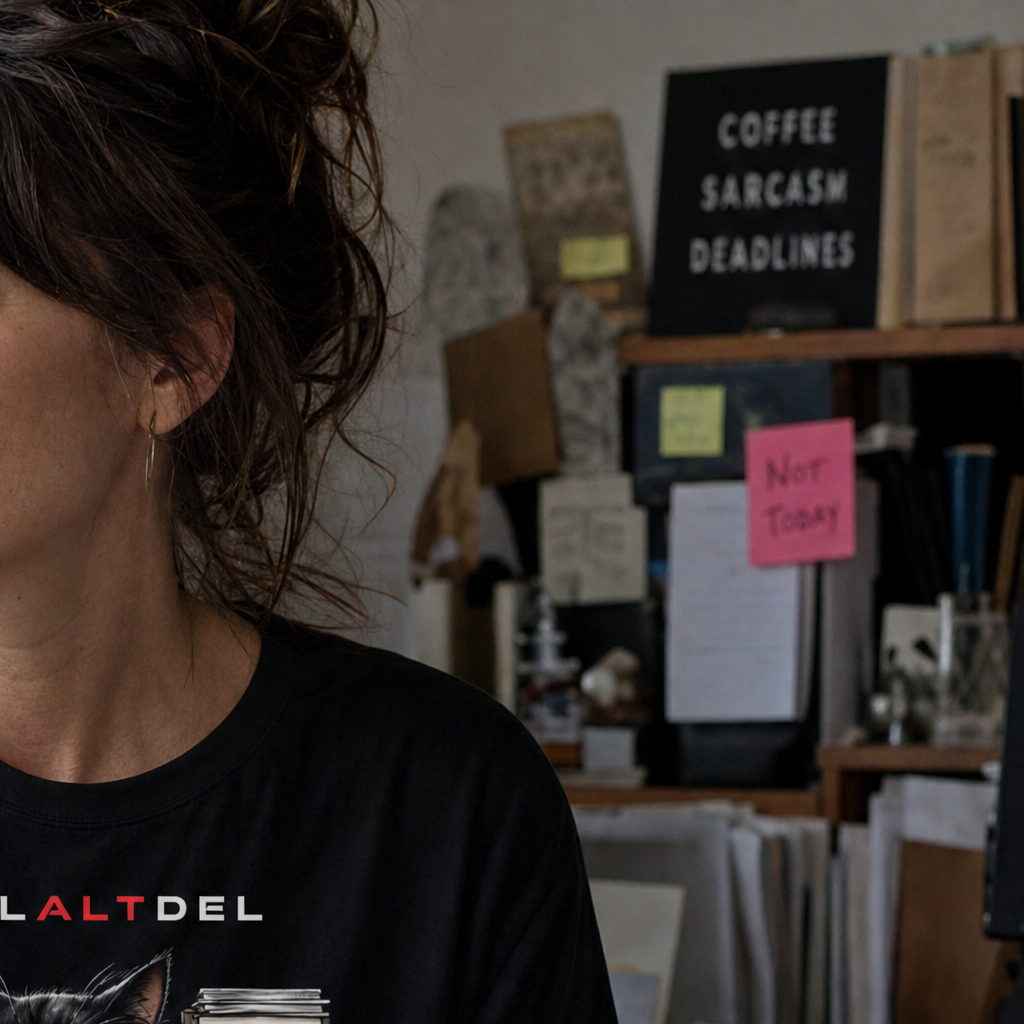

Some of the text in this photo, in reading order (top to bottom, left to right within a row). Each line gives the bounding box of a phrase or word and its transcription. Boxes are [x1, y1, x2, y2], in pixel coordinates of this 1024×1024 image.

[717, 106, 837, 149] COFFEE
[700, 168, 849, 212] SARCASM
[689, 231, 855, 274] DEADLINES
